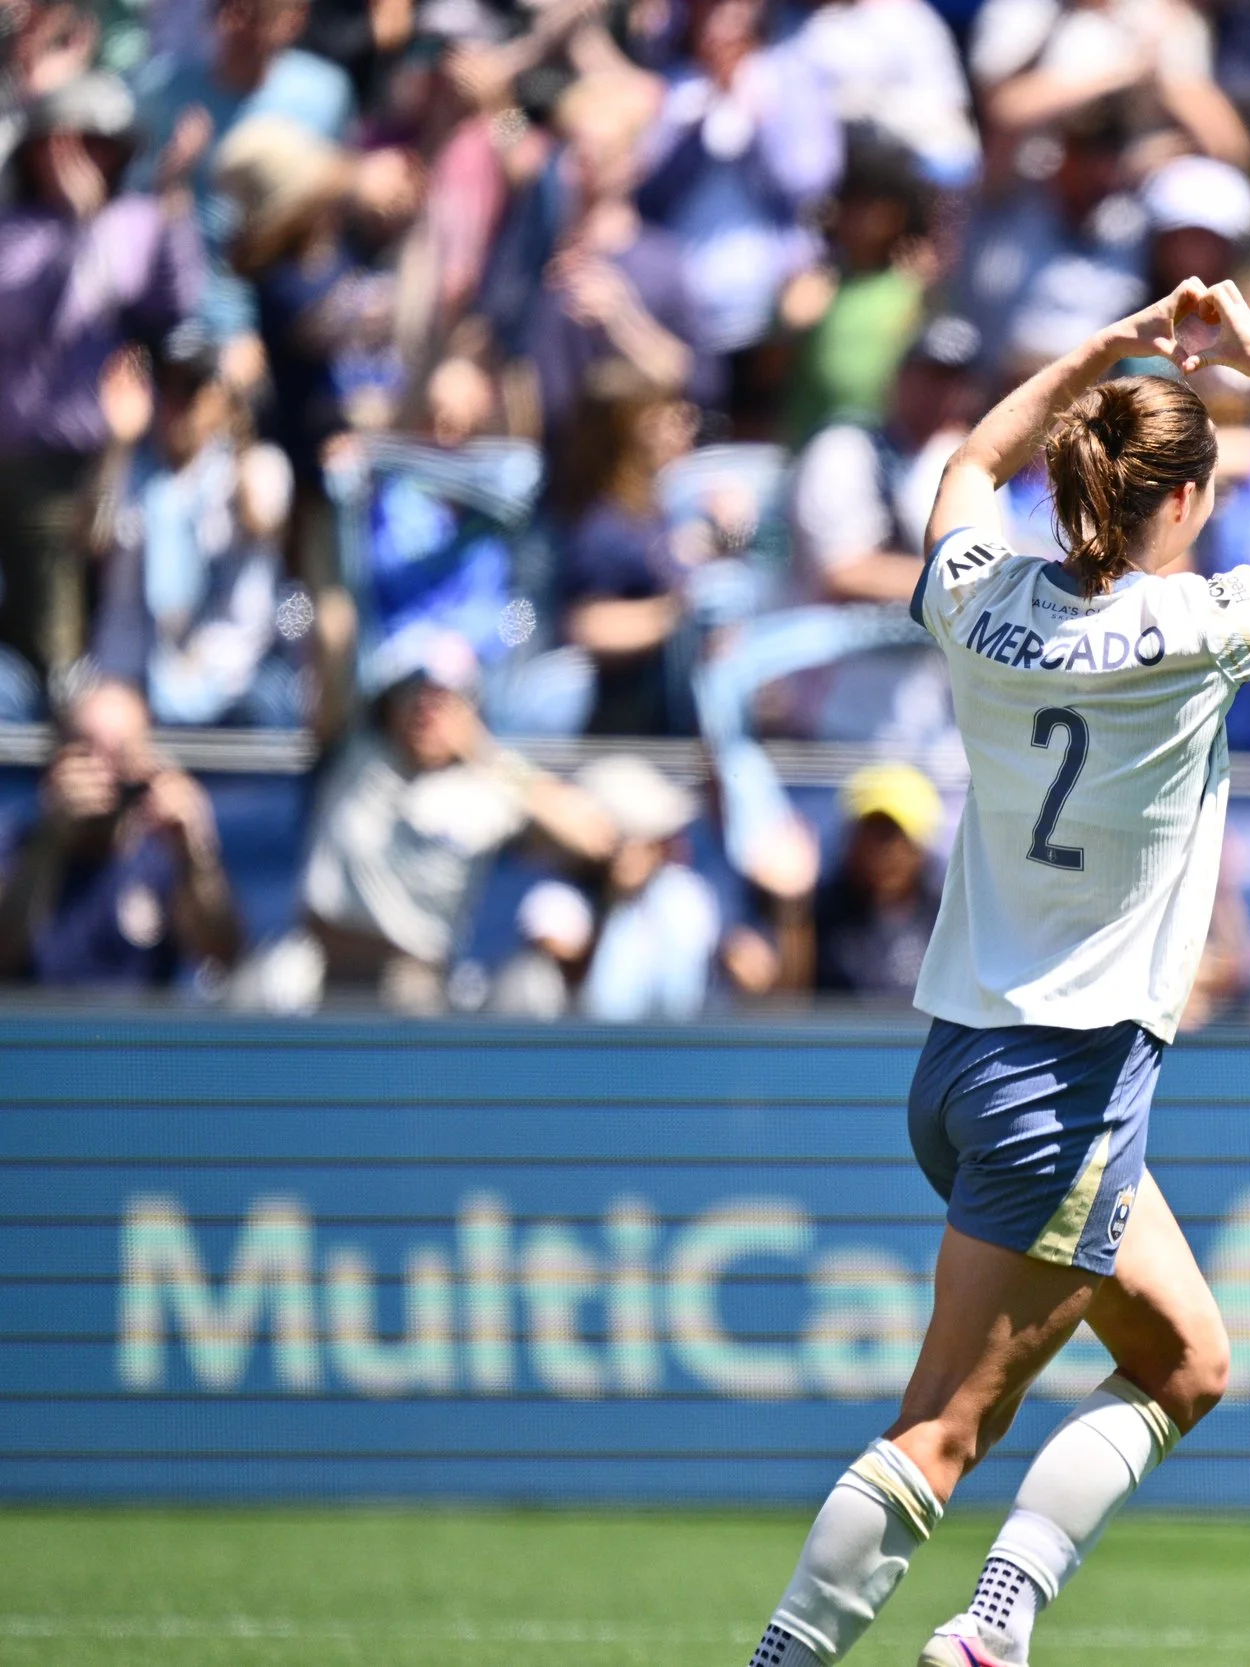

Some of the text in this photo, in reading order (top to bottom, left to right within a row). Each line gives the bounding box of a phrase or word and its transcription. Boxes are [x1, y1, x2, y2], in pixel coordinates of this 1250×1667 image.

[966, 610, 1165, 671] MERCADO
[1031, 598, 1079, 616] AULA'S
[1027, 706, 1088, 871] 2
[116, 1190, 1105, 1403] MultiCa
